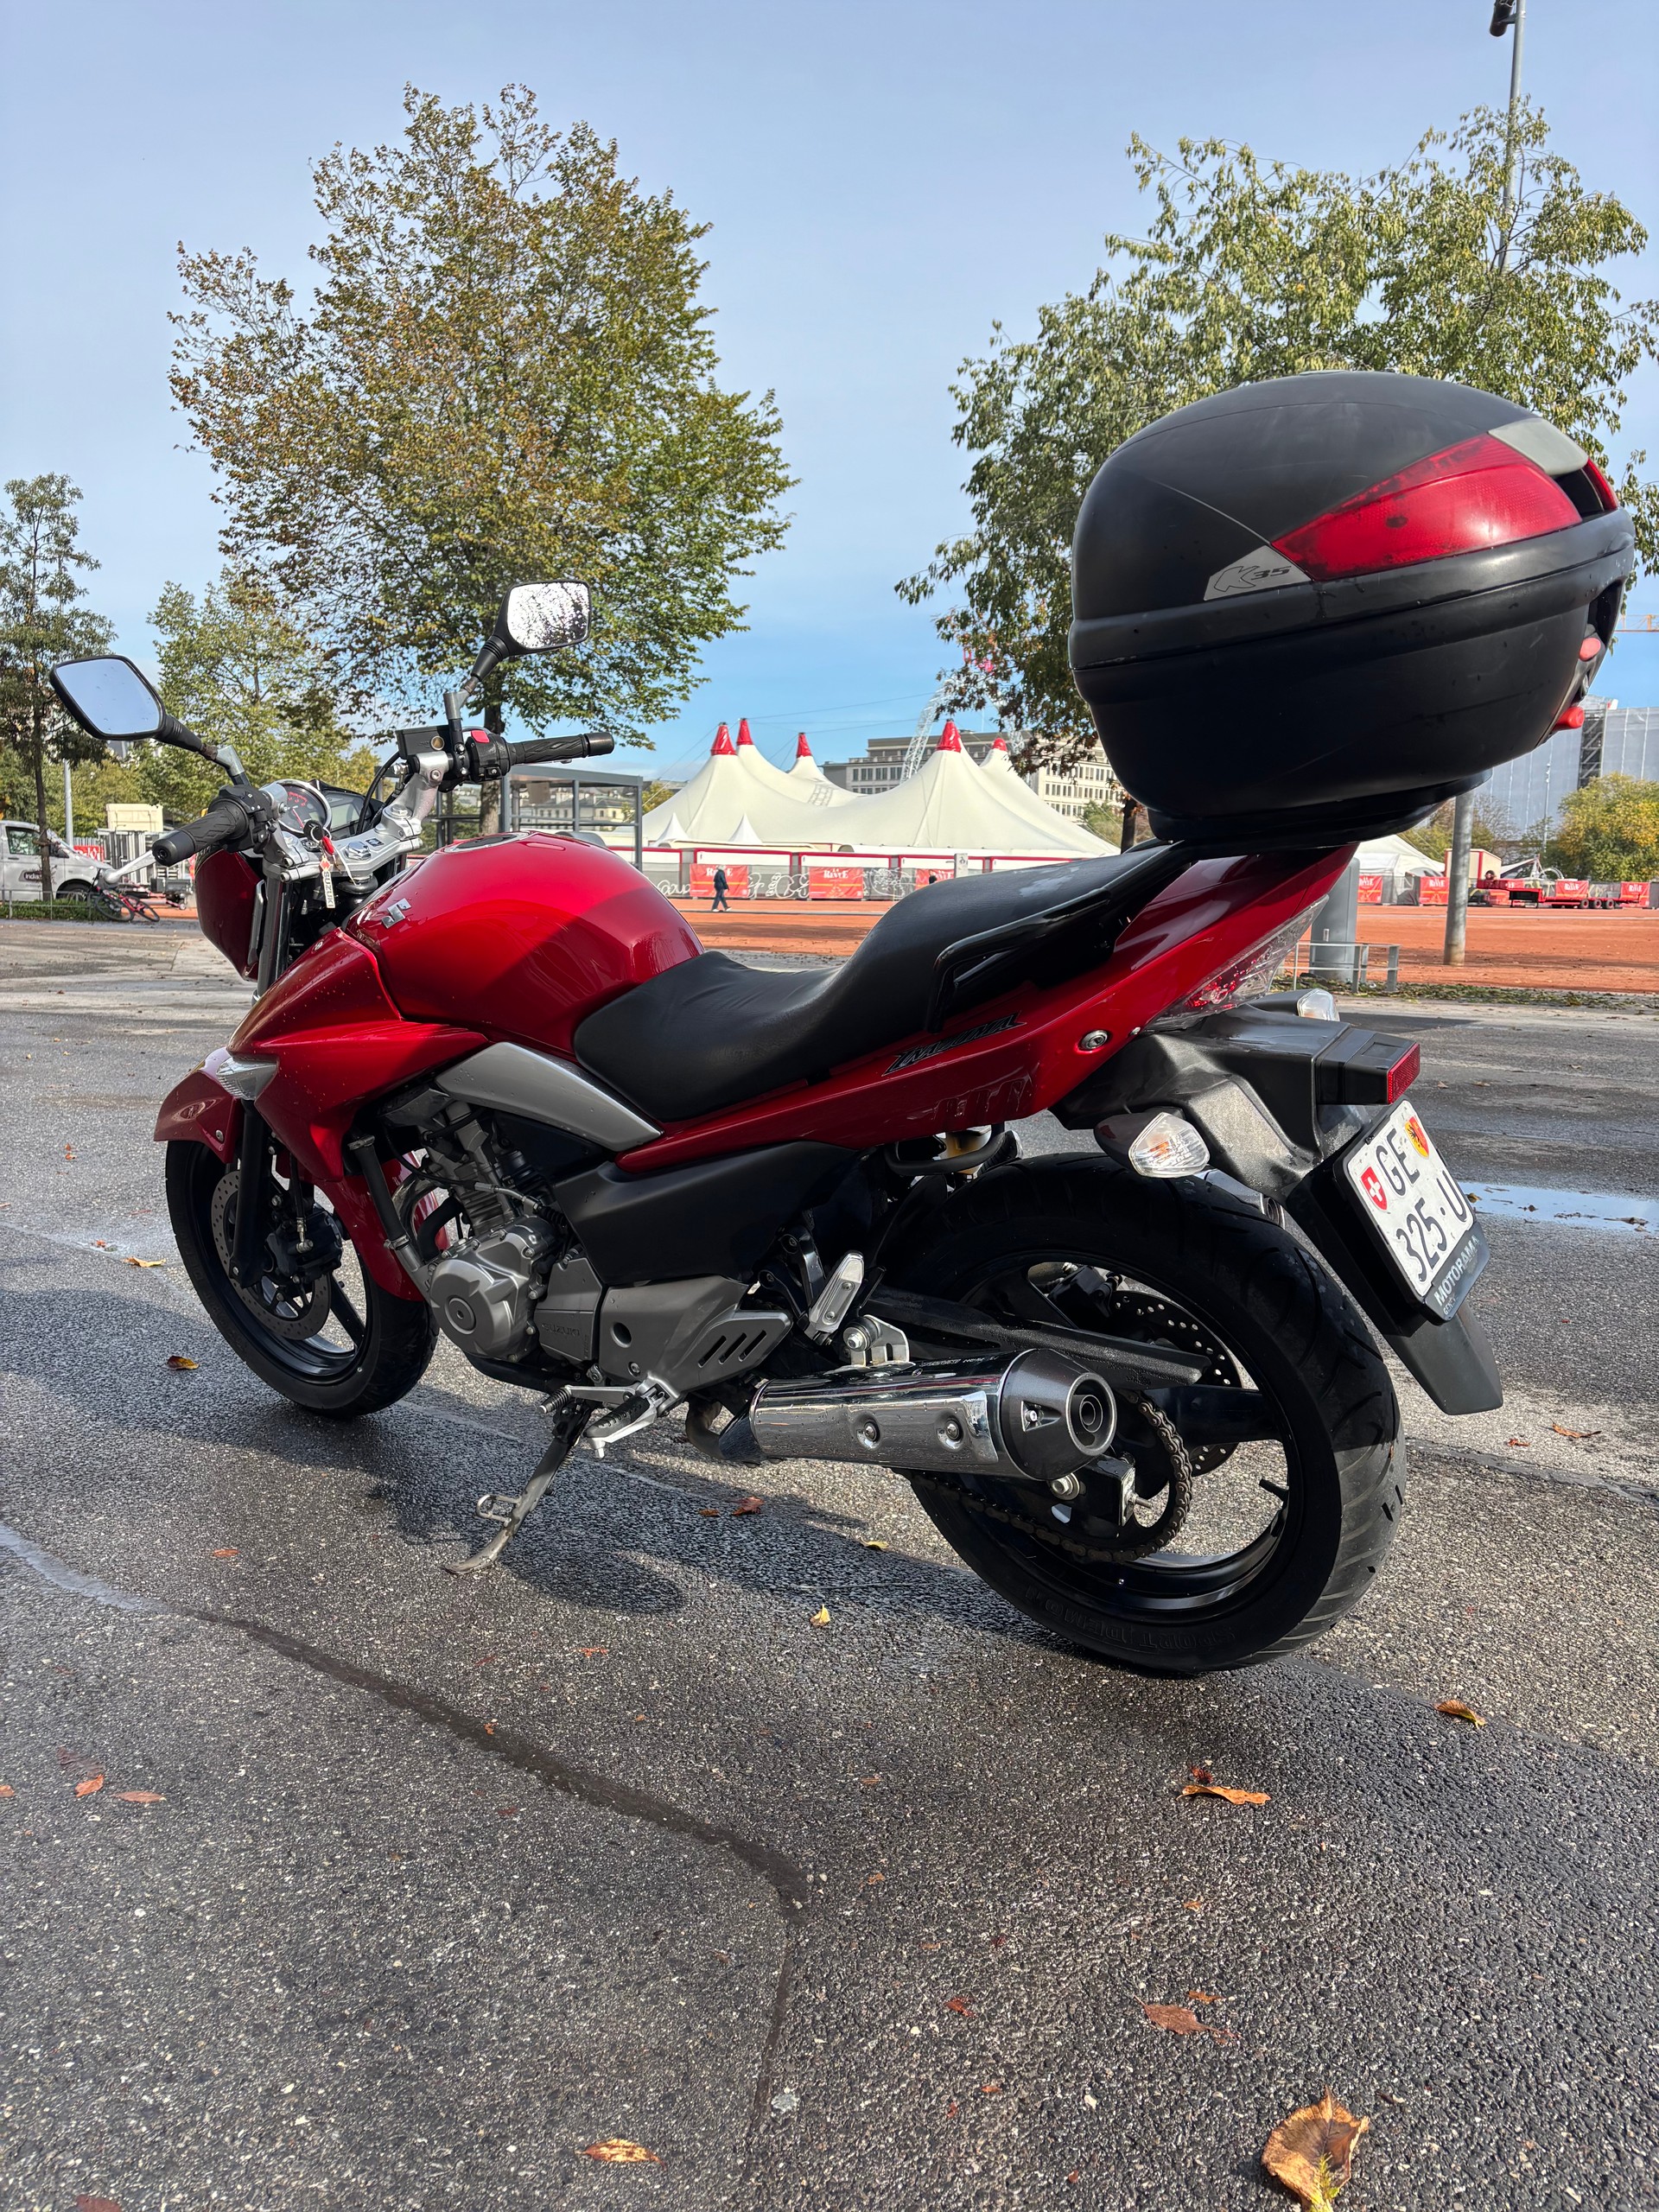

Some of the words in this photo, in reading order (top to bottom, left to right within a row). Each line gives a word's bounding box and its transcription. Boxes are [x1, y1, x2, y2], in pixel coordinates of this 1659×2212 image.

[322, 871, 334, 907] SUZUKI
[1376, 1128, 1420, 1197] GE
[1433, 1235, 1480, 1306] MOTORAMA
[541, 1323, 581, 1337] SUZUKI
